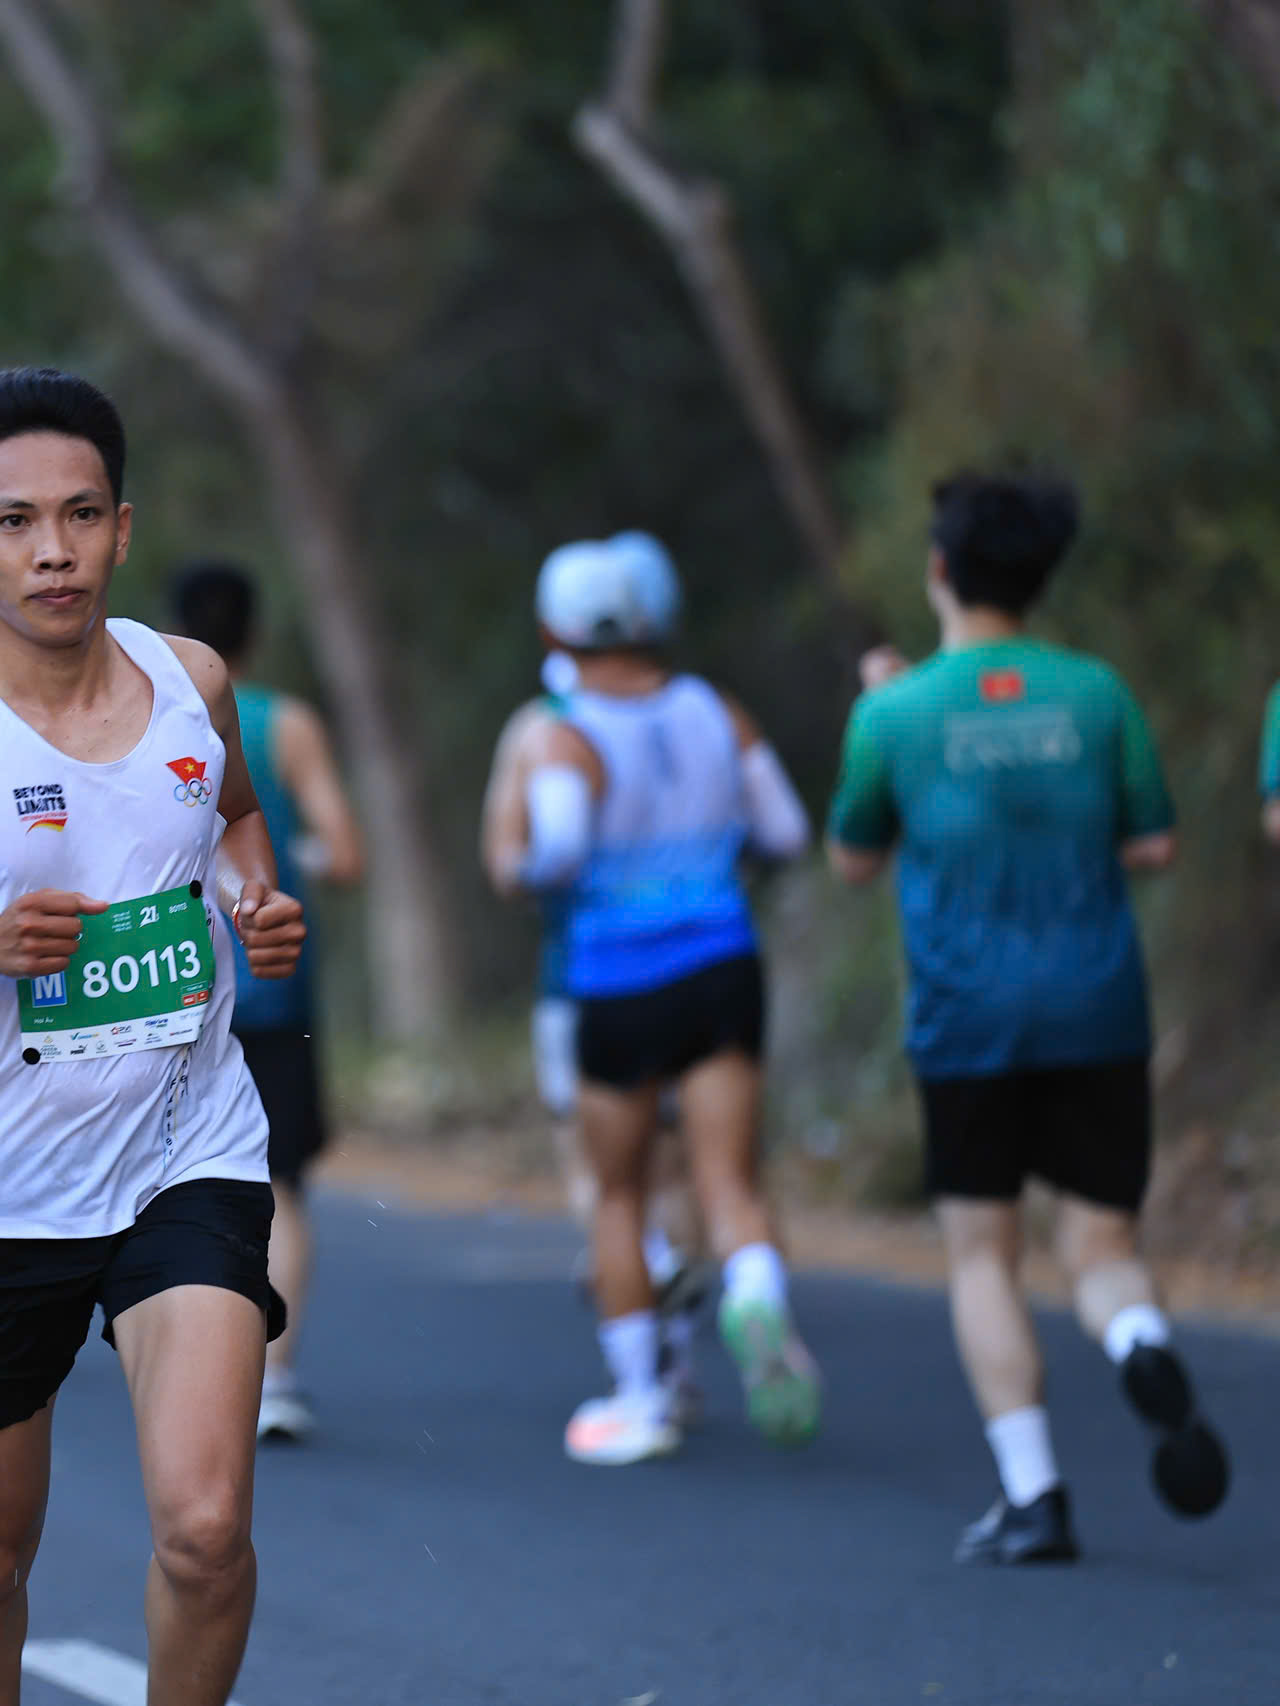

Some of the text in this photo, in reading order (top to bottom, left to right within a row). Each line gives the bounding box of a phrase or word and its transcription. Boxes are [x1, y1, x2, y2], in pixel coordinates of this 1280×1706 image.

[13, 784, 63, 799] BEYOND
[16, 796, 66, 816] LIMITS
[82, 940, 201, 998] 80113
[35, 972, 62, 1000] M
